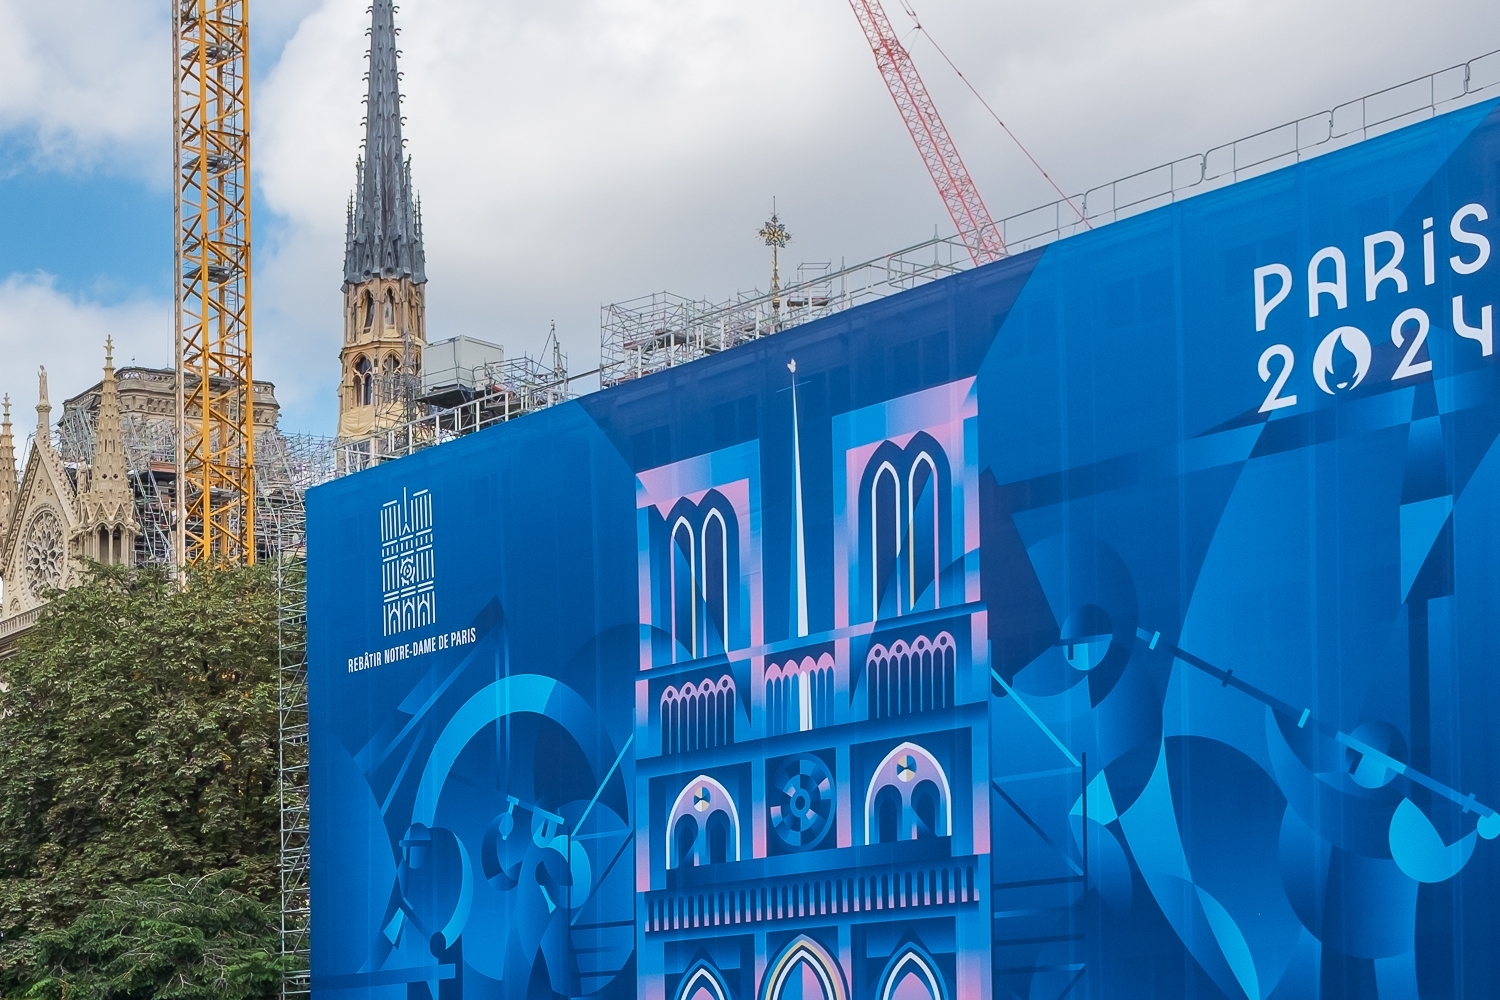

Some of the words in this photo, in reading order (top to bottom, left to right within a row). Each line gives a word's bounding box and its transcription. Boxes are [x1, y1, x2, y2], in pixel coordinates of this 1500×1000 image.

[1257, 295, 1493, 413] 2024
[348, 651, 382, 673] REBÂTIR
[384, 637, 437, 664] NOTRE-DAME
[438, 633, 449, 650] DE
[450, 627, 476, 647] PARIS
